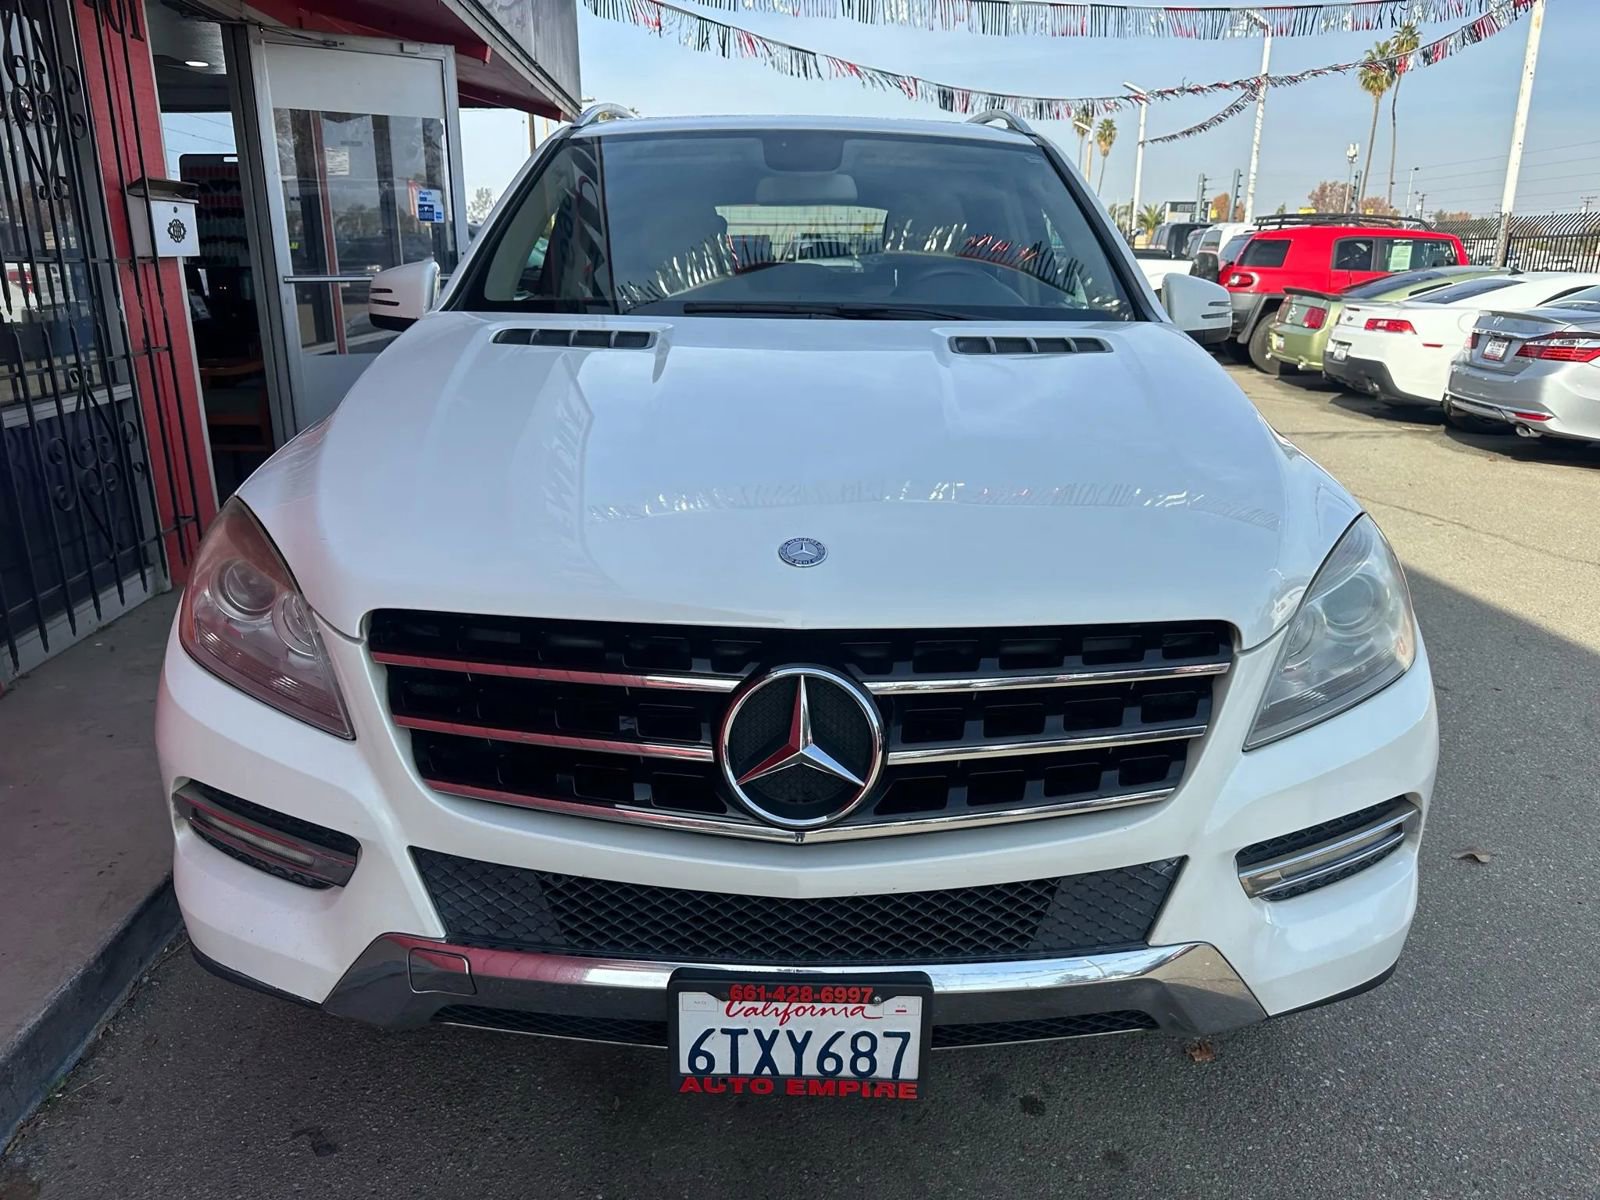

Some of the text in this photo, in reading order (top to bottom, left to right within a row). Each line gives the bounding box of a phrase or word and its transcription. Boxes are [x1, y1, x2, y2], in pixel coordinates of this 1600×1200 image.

[729, 984, 874, 1004] 661-428-6997
[725, 1000, 883, 1026] California
[687, 1027, 912, 1080] 6TXY687
[679, 1076, 918, 1099] AUTO EMPIRE
